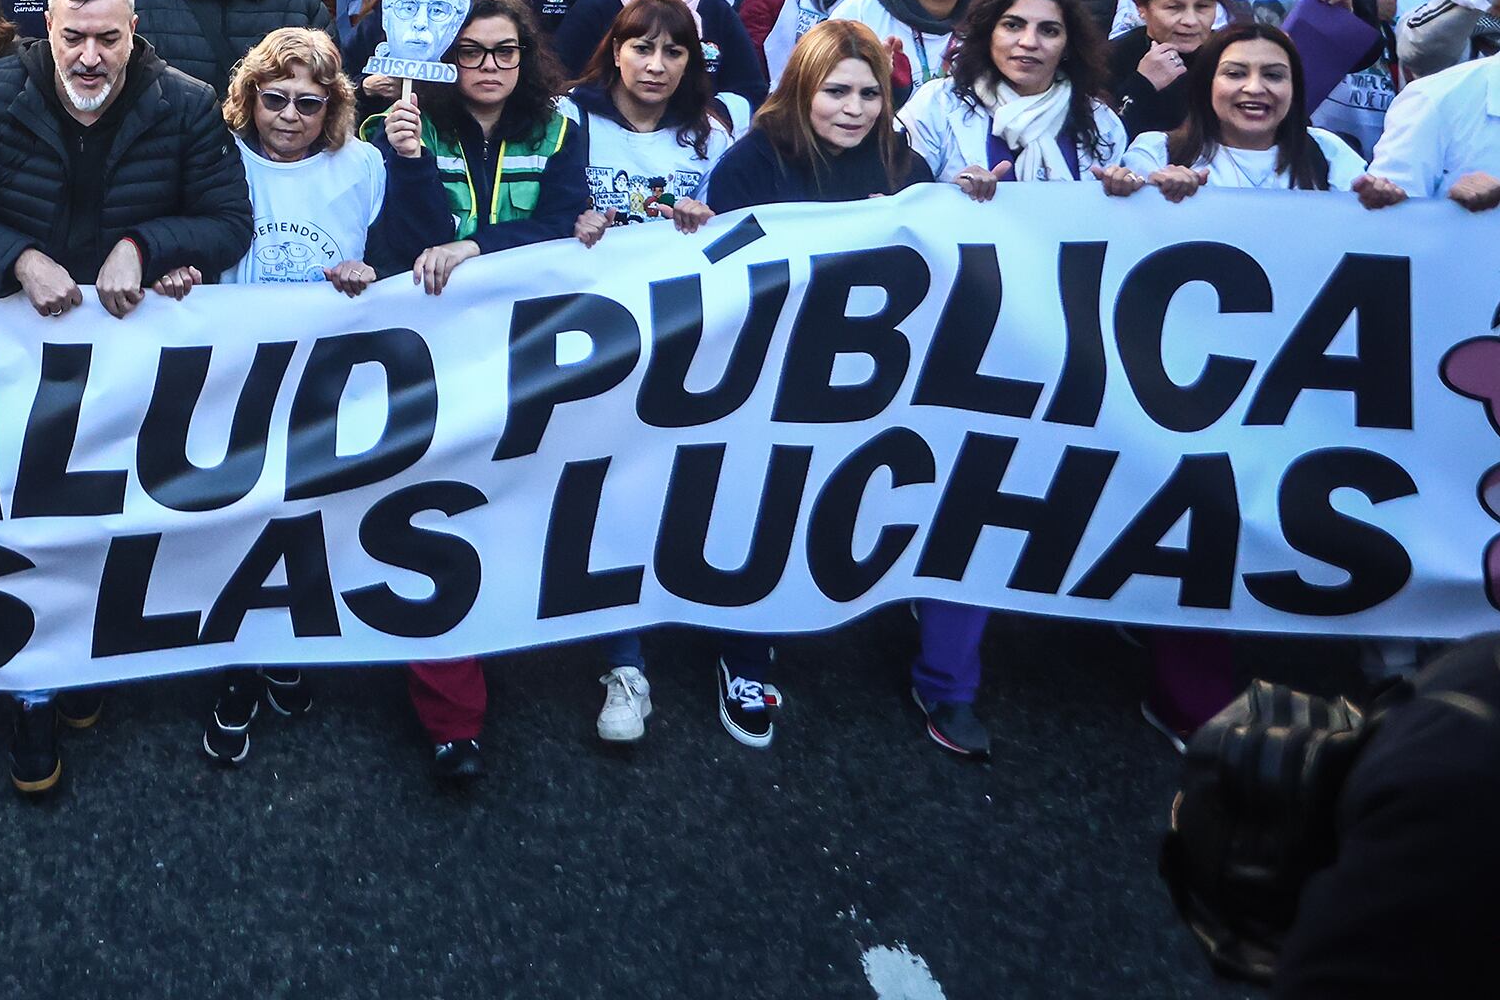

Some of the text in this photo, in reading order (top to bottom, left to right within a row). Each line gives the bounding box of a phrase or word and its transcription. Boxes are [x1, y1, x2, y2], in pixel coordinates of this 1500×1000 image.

[367, 58, 456, 82] BUSCADO
[252, 221, 336, 260] DEFIENDO LA
[490, 212, 1414, 462] PÚBLICA
[90, 479, 490, 662] LAS
[534, 425, 1420, 621] LUCHAS
